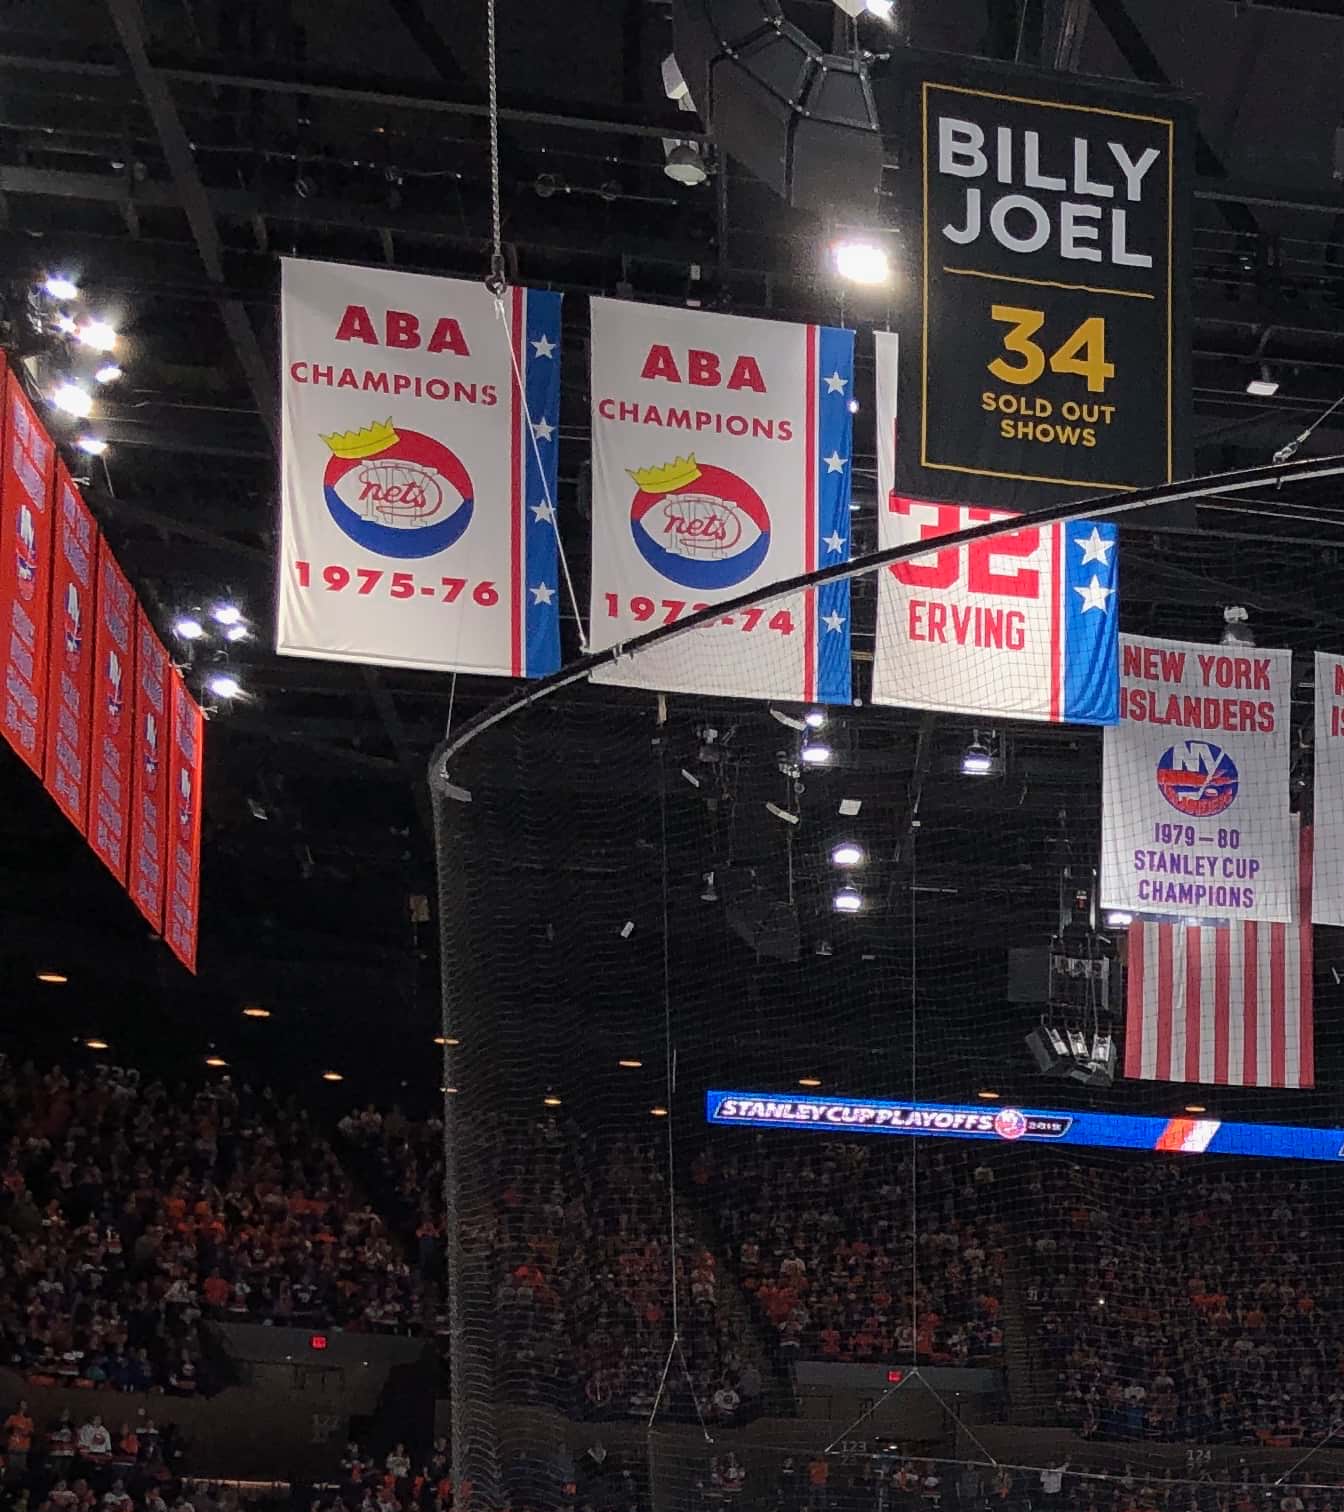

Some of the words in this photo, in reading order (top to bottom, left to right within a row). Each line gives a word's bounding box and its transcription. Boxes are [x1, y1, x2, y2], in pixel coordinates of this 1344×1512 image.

[938, 116, 1160, 201] BILLY
[942, 188, 1152, 268] JOEL
[335, 305, 470, 356] ABA
[986, 304, 1115, 393] 34
[290, 361, 498, 406] CHAMPIONS
[640, 344, 767, 393] ABA
[598, 399, 793, 441] CHAMPIONS
[981, 392, 1053, 420] SOLD
[1062, 402, 1116, 425] OUT
[1000, 419, 1097, 448] SHOWS
[295, 561, 500, 607] 1975-76
[908, 601, 1026, 650] ERVING
[1123, 645, 1185, 683] NEW
[1198, 653, 1271, 691] YORK
[1120, 686, 1275, 733] ISLANDERS
[1154, 823, 1196, 847] 1979
[1217, 829, 1240, 849] 80
[1134, 850, 1219, 876] STANLEY
[1222, 857, 1260, 880] CUP
[1138, 879, 1254, 909] CHAMPIONS
[723, 1100, 826, 1121] STANLEY
[826, 1107, 877, 1124] CUP
[875, 1109, 993, 1131] PLAYOFFS
